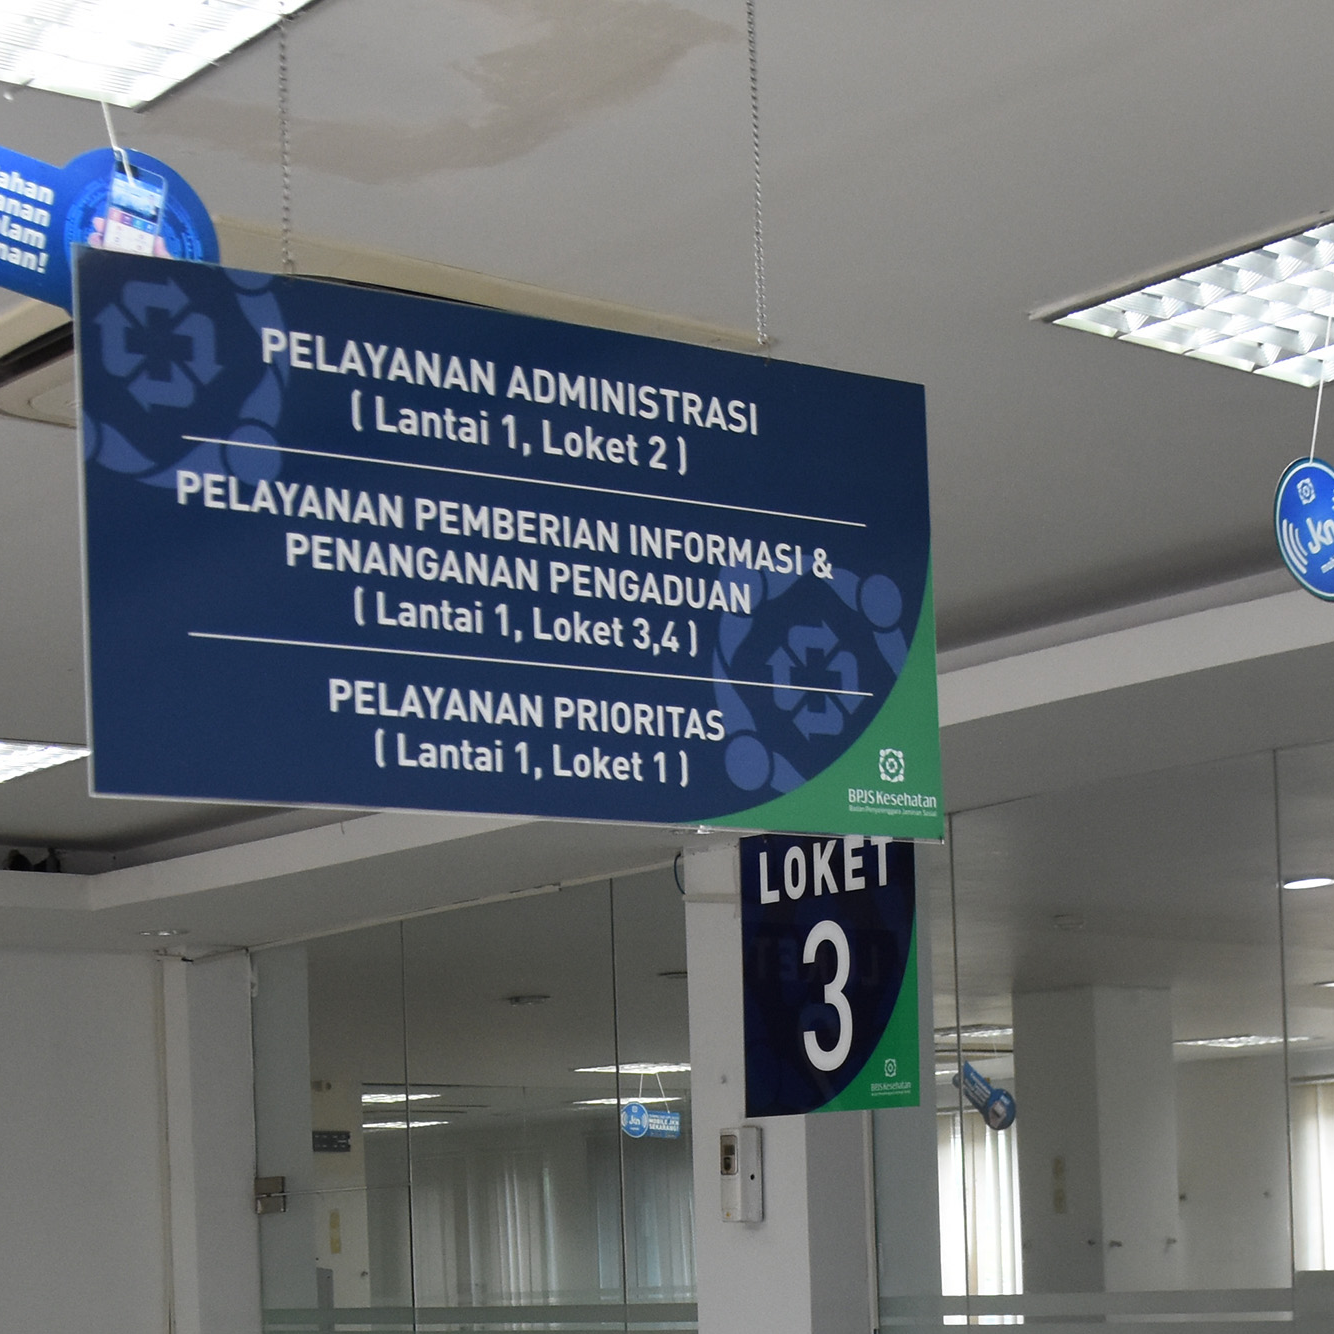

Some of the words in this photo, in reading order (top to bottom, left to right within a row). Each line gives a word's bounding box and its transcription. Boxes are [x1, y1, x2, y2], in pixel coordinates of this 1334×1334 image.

[262, 327, 496, 397] PELAYANAN
[506, 365, 758, 437] ADMINISTRASI
[375, 395, 490, 446] Lantai
[501, 414, 530, 457] 1,
[542, 419, 640, 467] Loket
[648, 435, 668, 471] 2
[177, 469, 404, 530] PELAYANAN
[415, 497, 620, 555] PEMBERIAN
[629, 524, 804, 577] INFORMASI
[812, 547, 835, 581] &
[286, 532, 539, 593] PENANGANAN
[549, 561, 752, 616] PENGADUAN
[376, 591, 484, 635] Lantai
[495, 603, 522, 643] 1,
[533, 607, 625, 648] Loket
[632, 617, 681, 657] 3,4
[329, 678, 544, 729] PELAYANAN
[554, 696, 726, 742] PRIORITAS
[397, 732, 504, 774] Lantai
[515, 741, 543, 781] 1,
[552, 743, 644, 783] Loket
[653, 751, 667, 784] 1
[848, 788, 875, 804] BPJS
[876, 791, 937, 808] Kesehatan
[759, 834, 894, 905] LOKET
[802, 920, 854, 1072] 3
